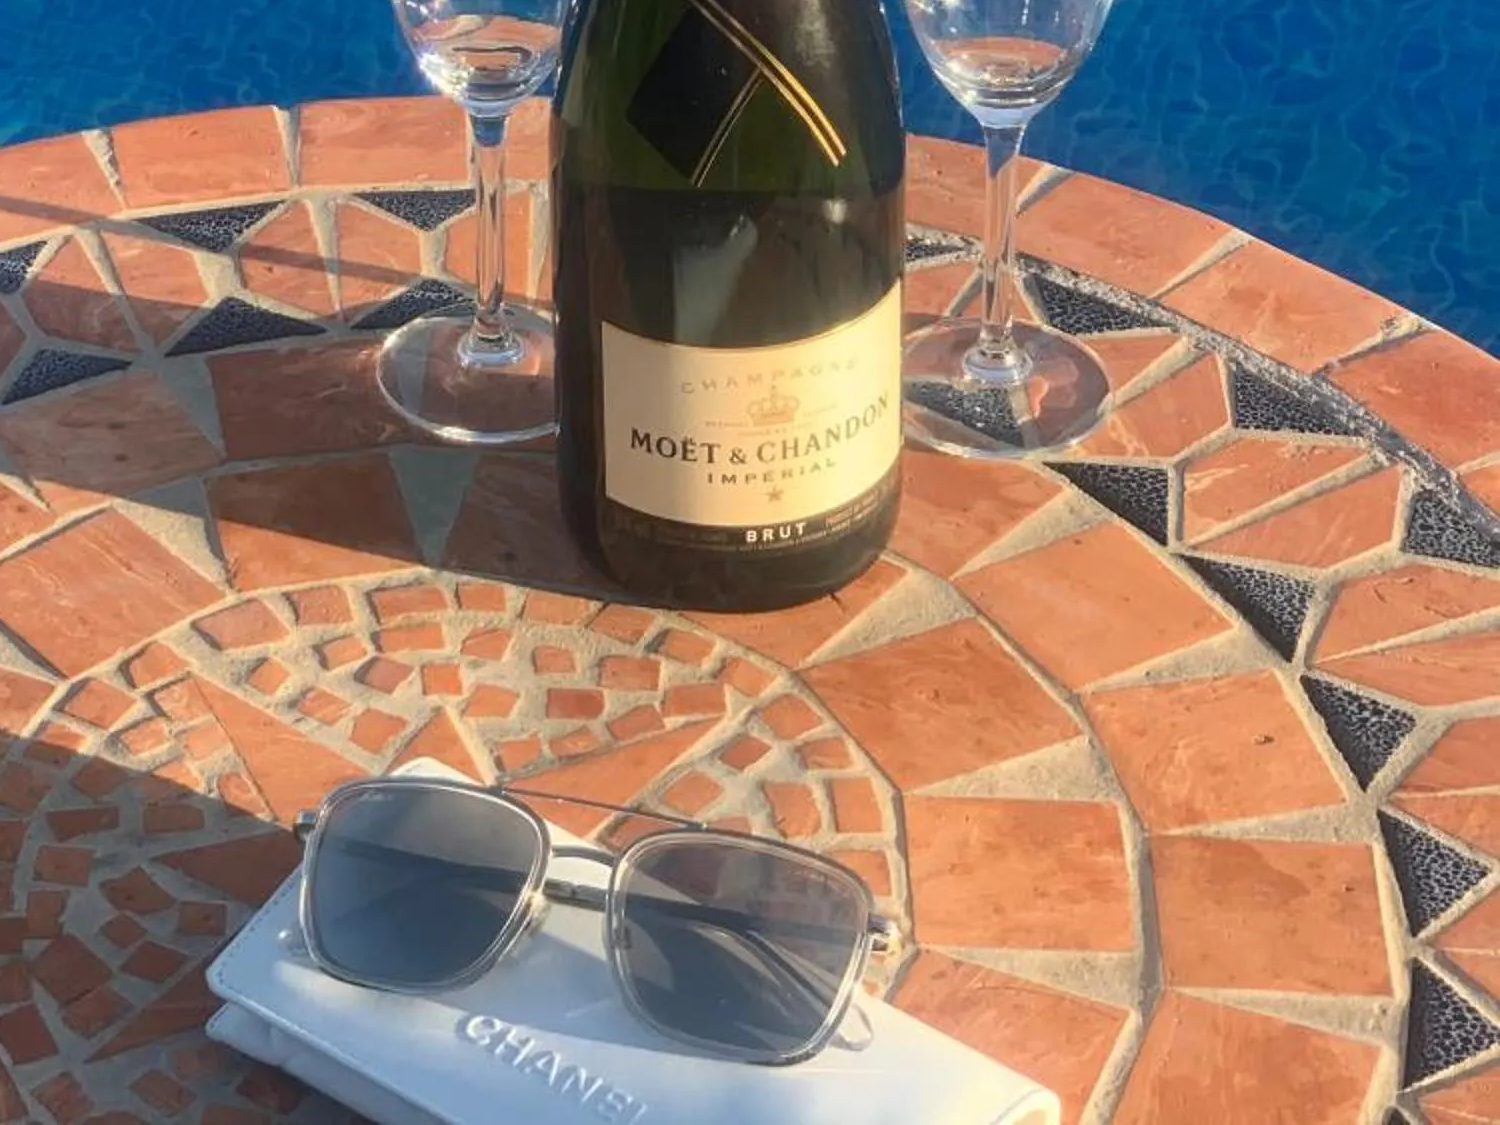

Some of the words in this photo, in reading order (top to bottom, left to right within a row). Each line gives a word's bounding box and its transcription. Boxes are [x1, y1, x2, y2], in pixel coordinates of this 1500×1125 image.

[630, 427, 721, 465] MOËT
[729, 446, 747, 466] &
[756, 389, 890, 465] CHANDON
[745, 522, 807, 544] BRUT
